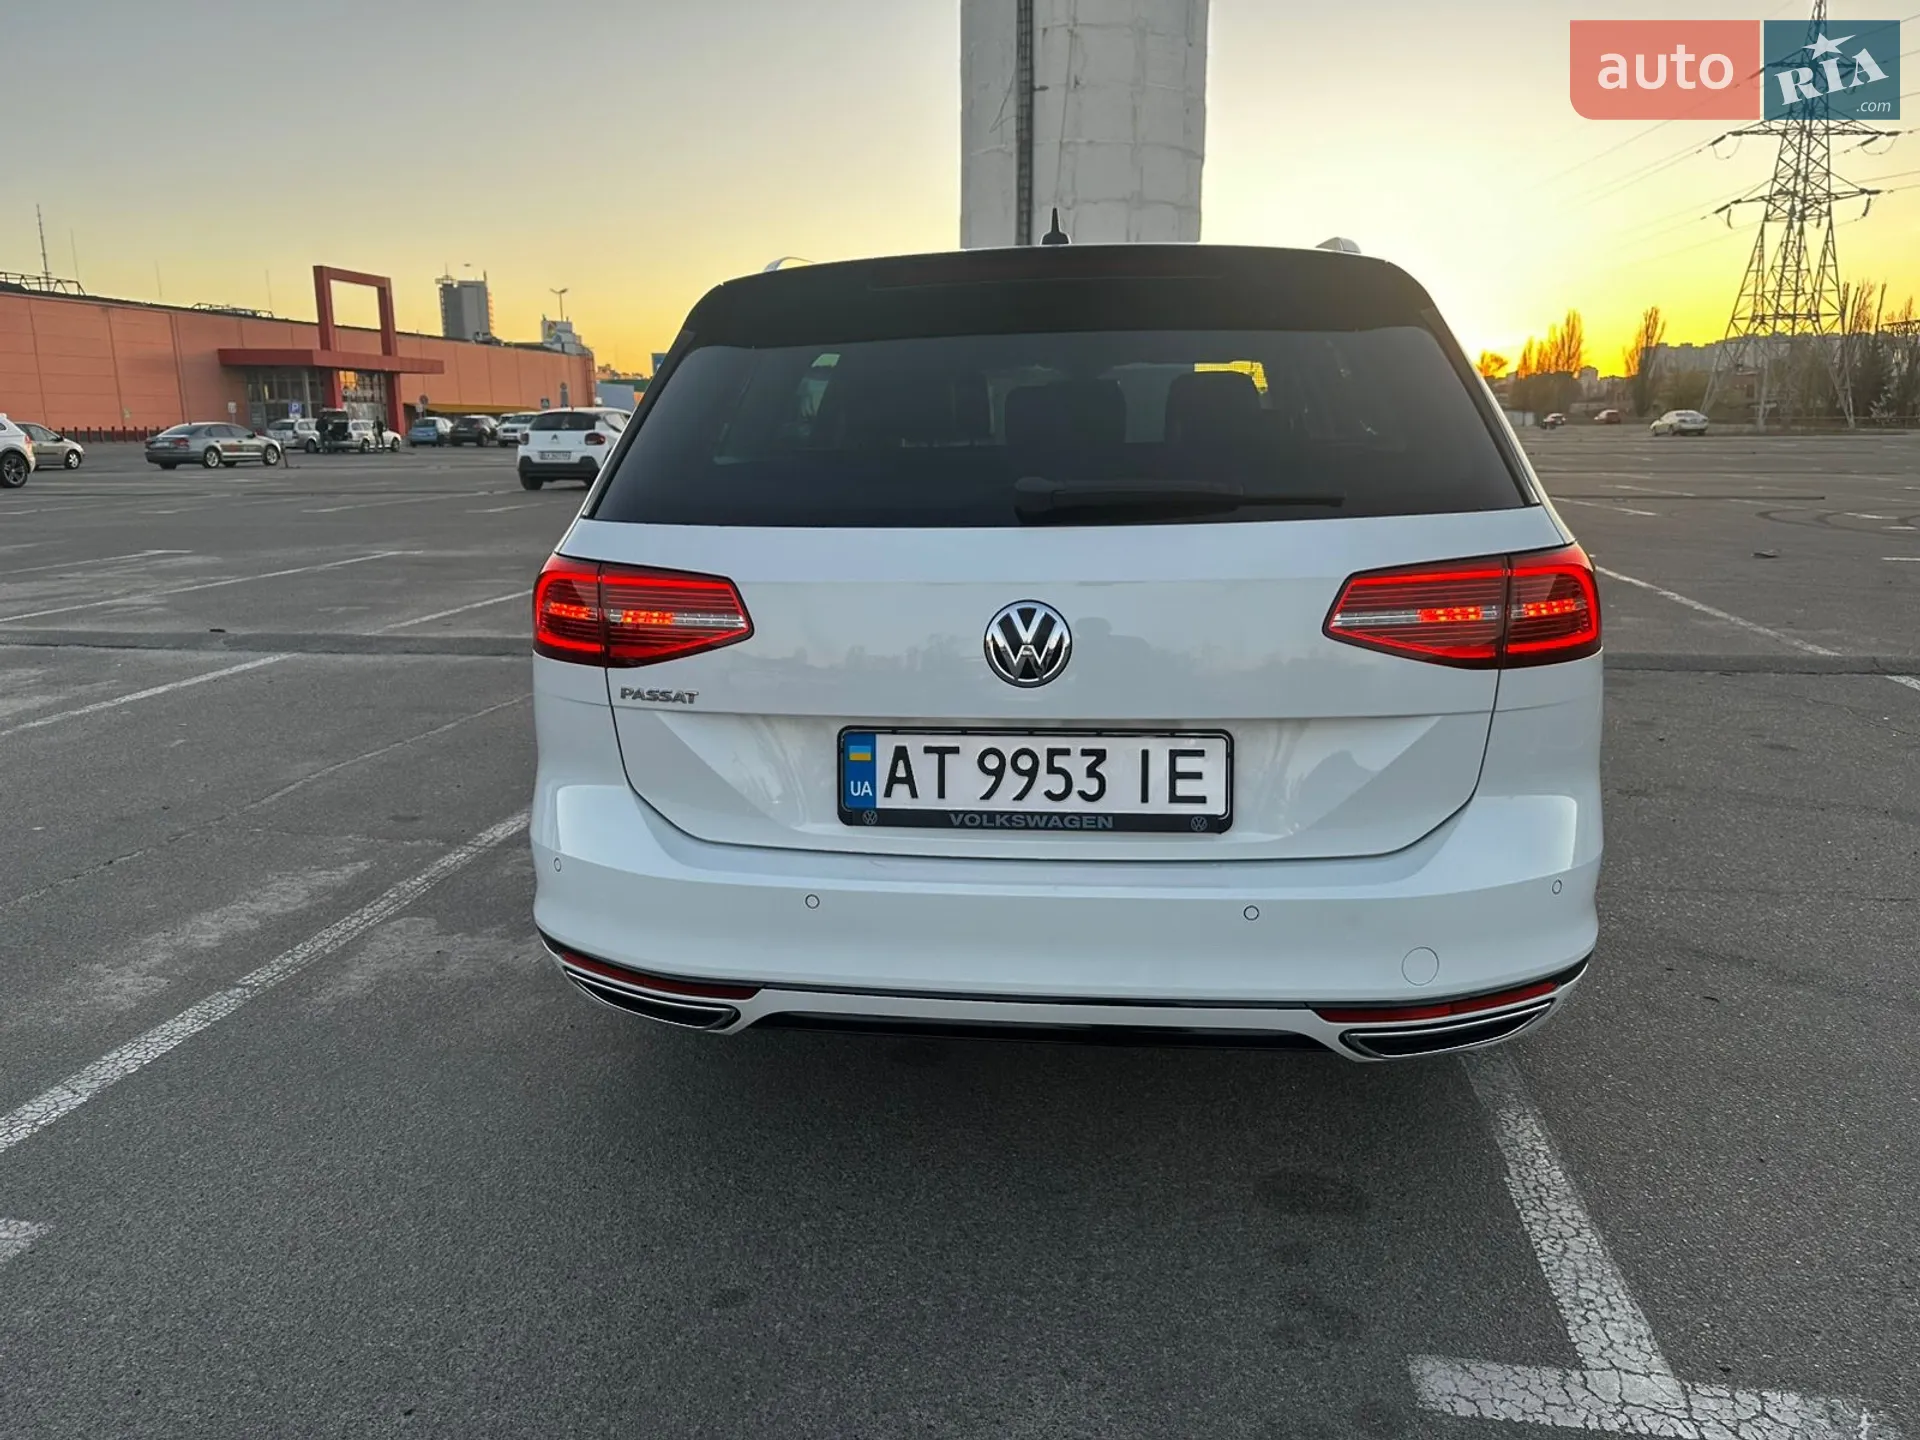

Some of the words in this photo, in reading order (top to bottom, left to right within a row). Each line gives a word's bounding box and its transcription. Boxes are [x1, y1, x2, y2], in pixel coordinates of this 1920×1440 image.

[620, 687, 699, 704] PASSAT
[883, 745, 960, 800] AT
[977, 747, 1107, 802] 9953
[1140, 748, 1208, 805] IE
[850, 780, 873, 797] UA
[949, 812, 1114, 830] VOLKSWAGEN
